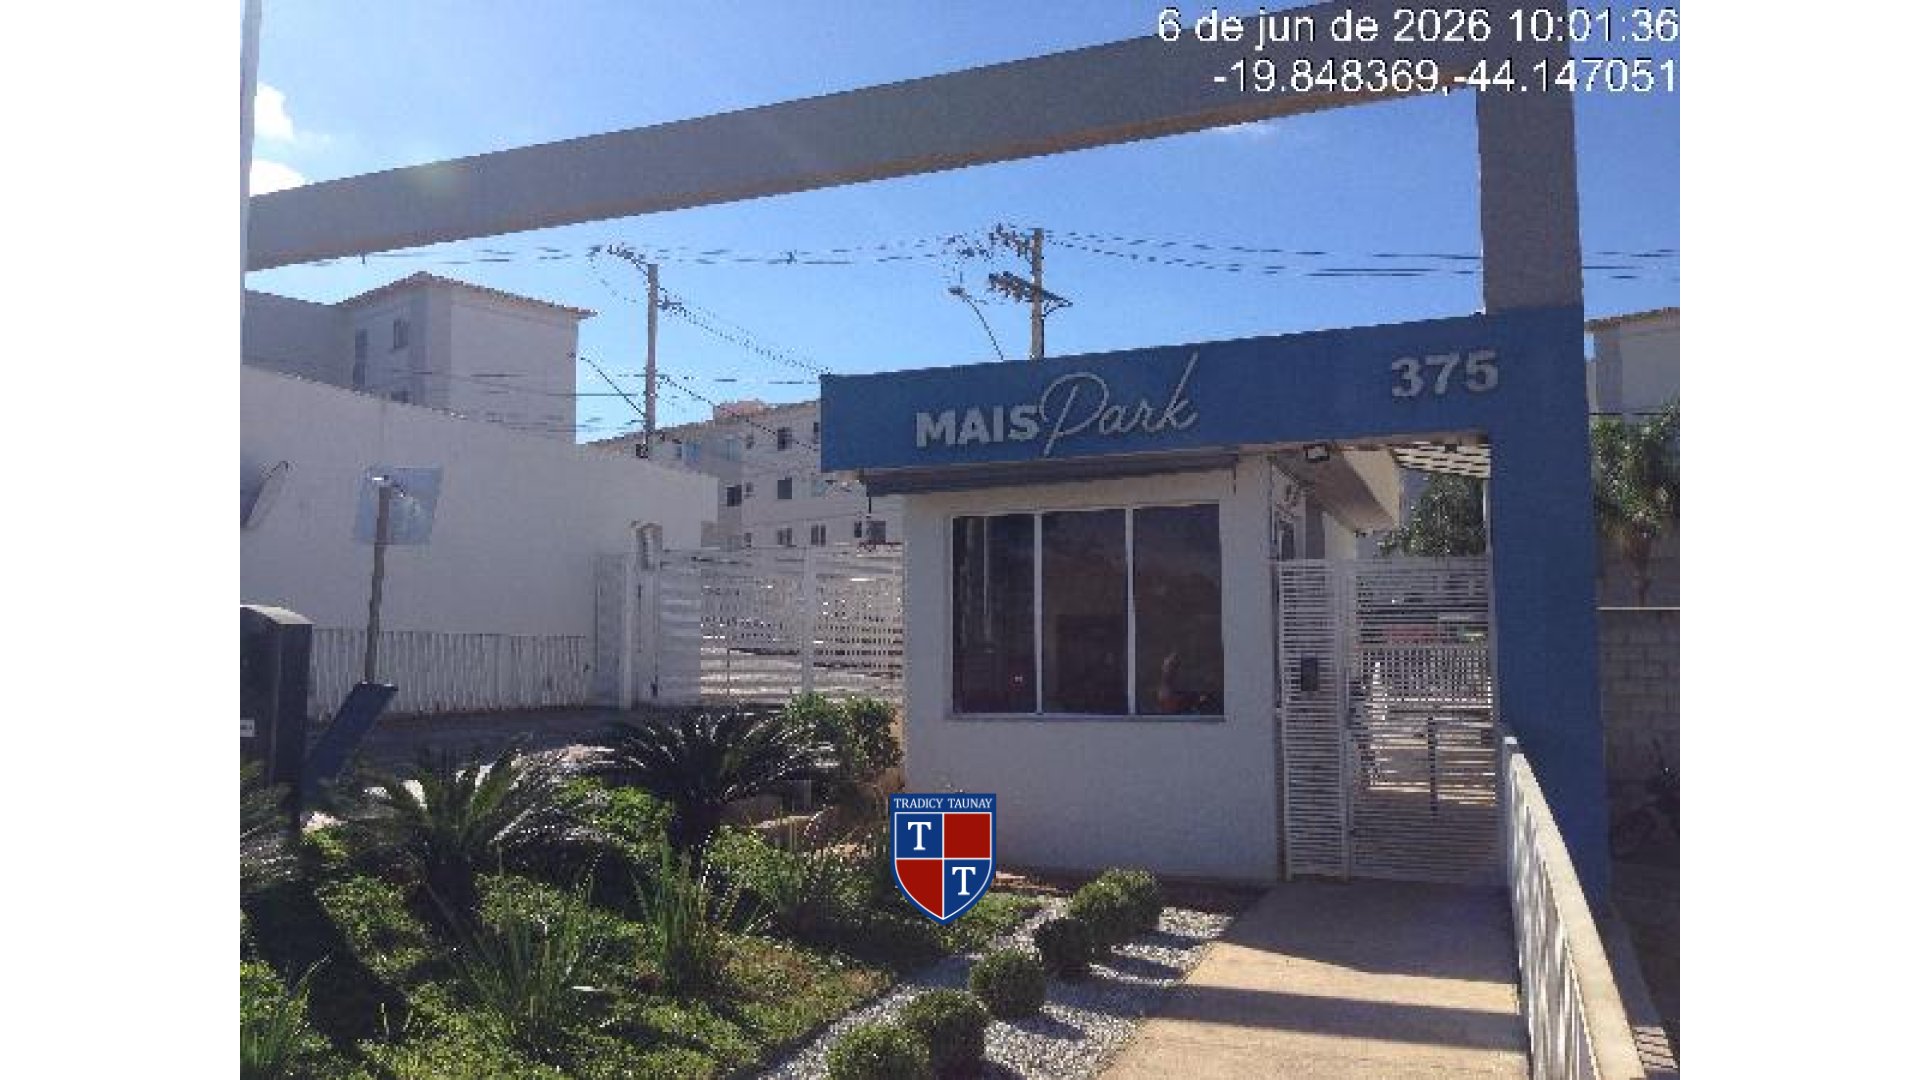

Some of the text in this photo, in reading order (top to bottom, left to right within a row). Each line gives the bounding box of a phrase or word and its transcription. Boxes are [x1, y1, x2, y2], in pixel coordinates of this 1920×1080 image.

[915, 351, 1199, 457] MAIS Park
[1389, 349, 1500, 399] 375
